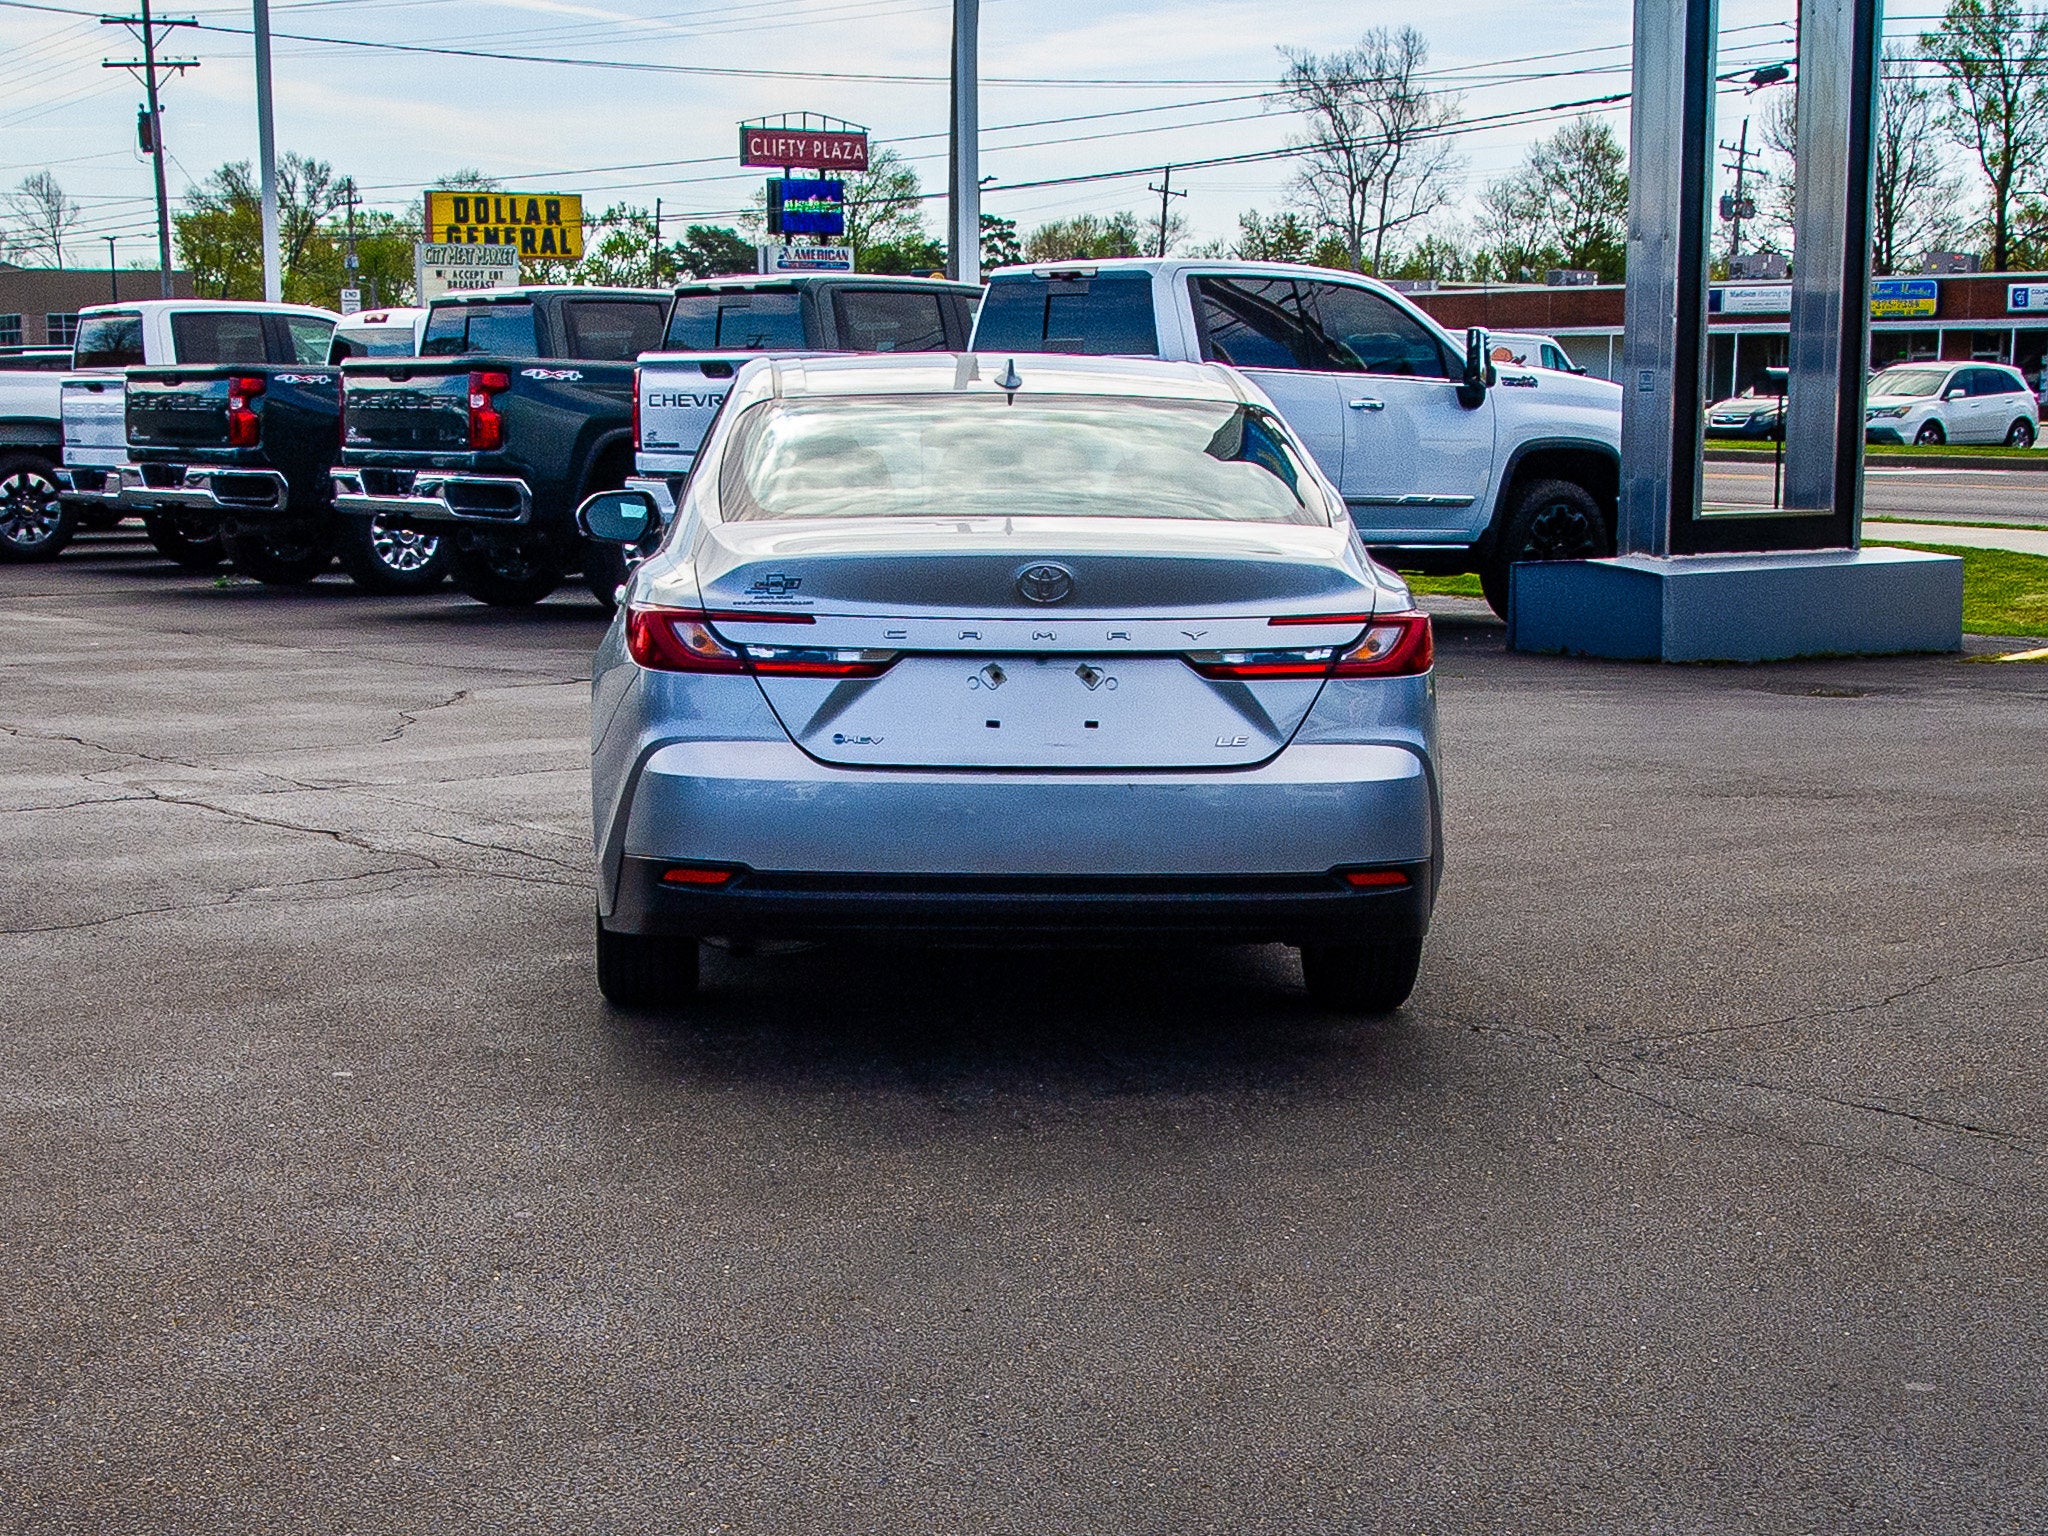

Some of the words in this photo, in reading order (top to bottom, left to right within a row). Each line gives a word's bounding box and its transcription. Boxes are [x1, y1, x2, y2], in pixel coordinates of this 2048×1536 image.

[750, 137, 806, 158] CLIFTY
[813, 140, 864, 160] PLAZA
[453, 196, 563, 226] DOLLAR
[446, 224, 573, 255] GENERAL
[425, 246, 446, 265] CITY
[447, 245, 475, 266] MEAT
[476, 246, 517, 266] MARKET
[794, 248, 849, 261] AMERICAN
[452, 269, 485, 280] ACCEPT
[447, 280, 496, 290] BREAKFAST
[883, 630, 1208, 641] CAMRY
[1215, 735, 1250, 748] LE
